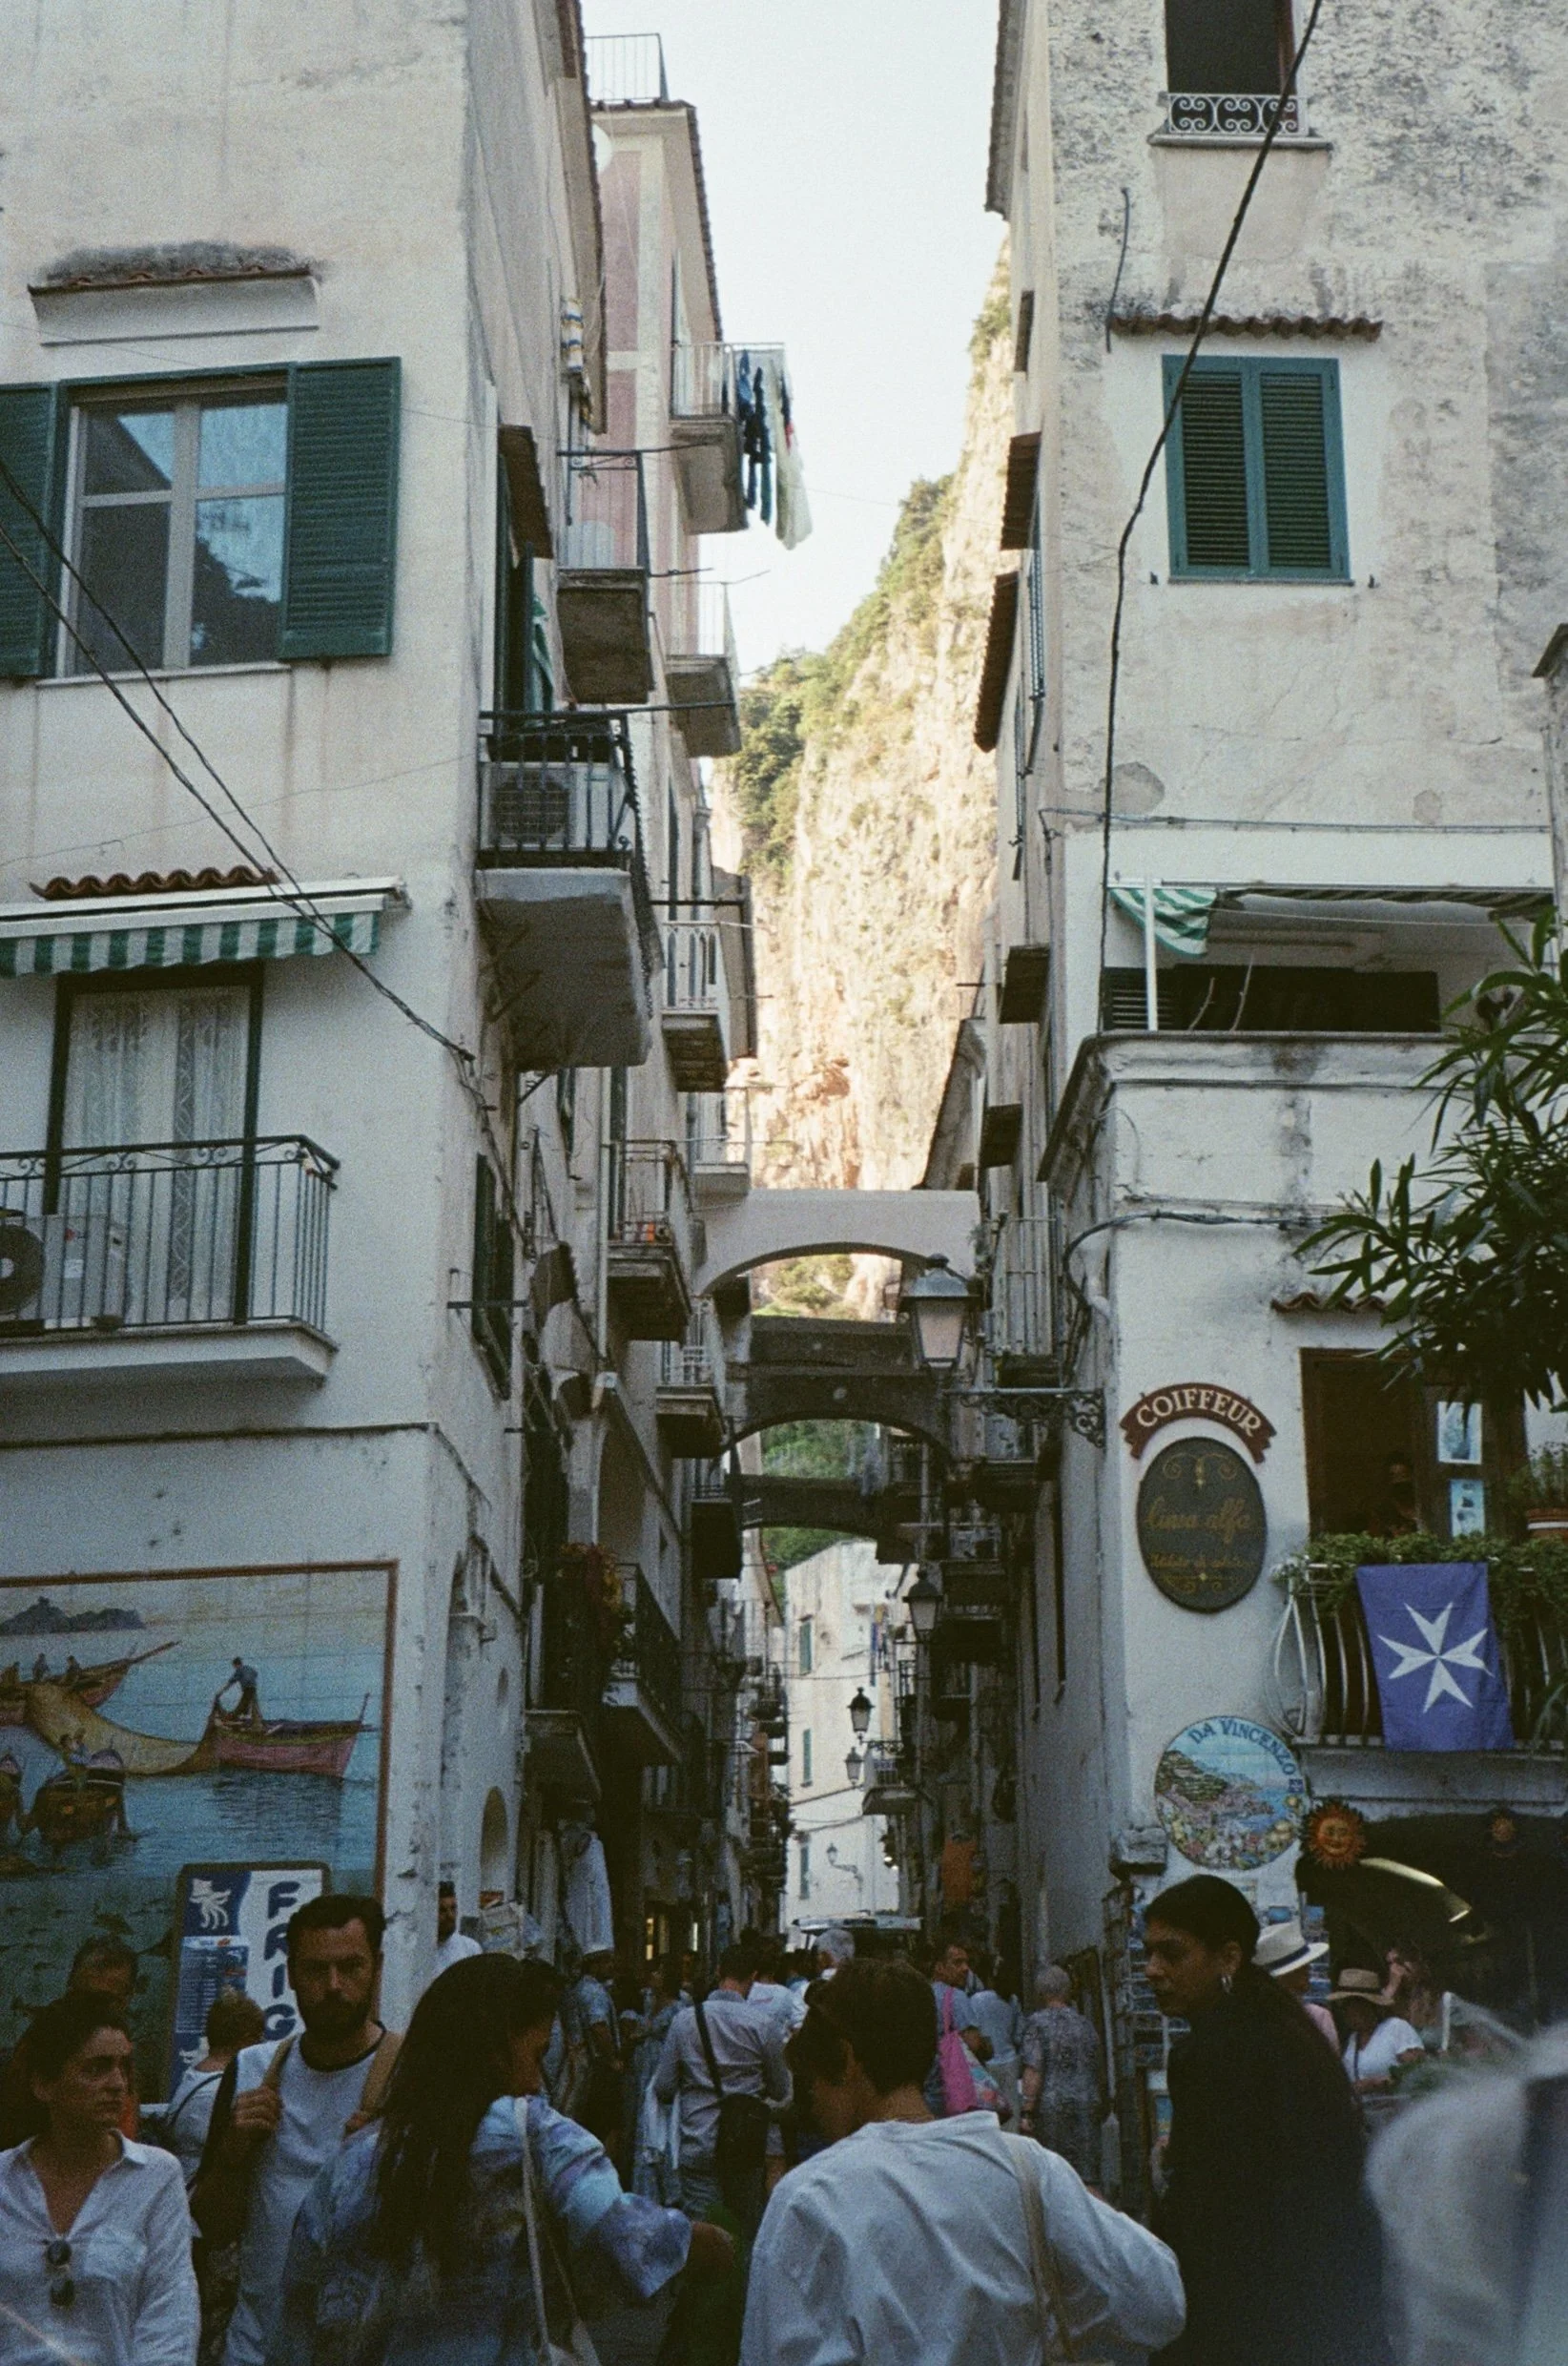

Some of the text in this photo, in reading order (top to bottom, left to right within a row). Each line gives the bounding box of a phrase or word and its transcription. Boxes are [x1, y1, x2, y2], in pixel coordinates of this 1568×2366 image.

[1136, 1388, 1262, 1437] COIFFEUR
[1188, 1719, 1296, 1775] DA VINCENZO
